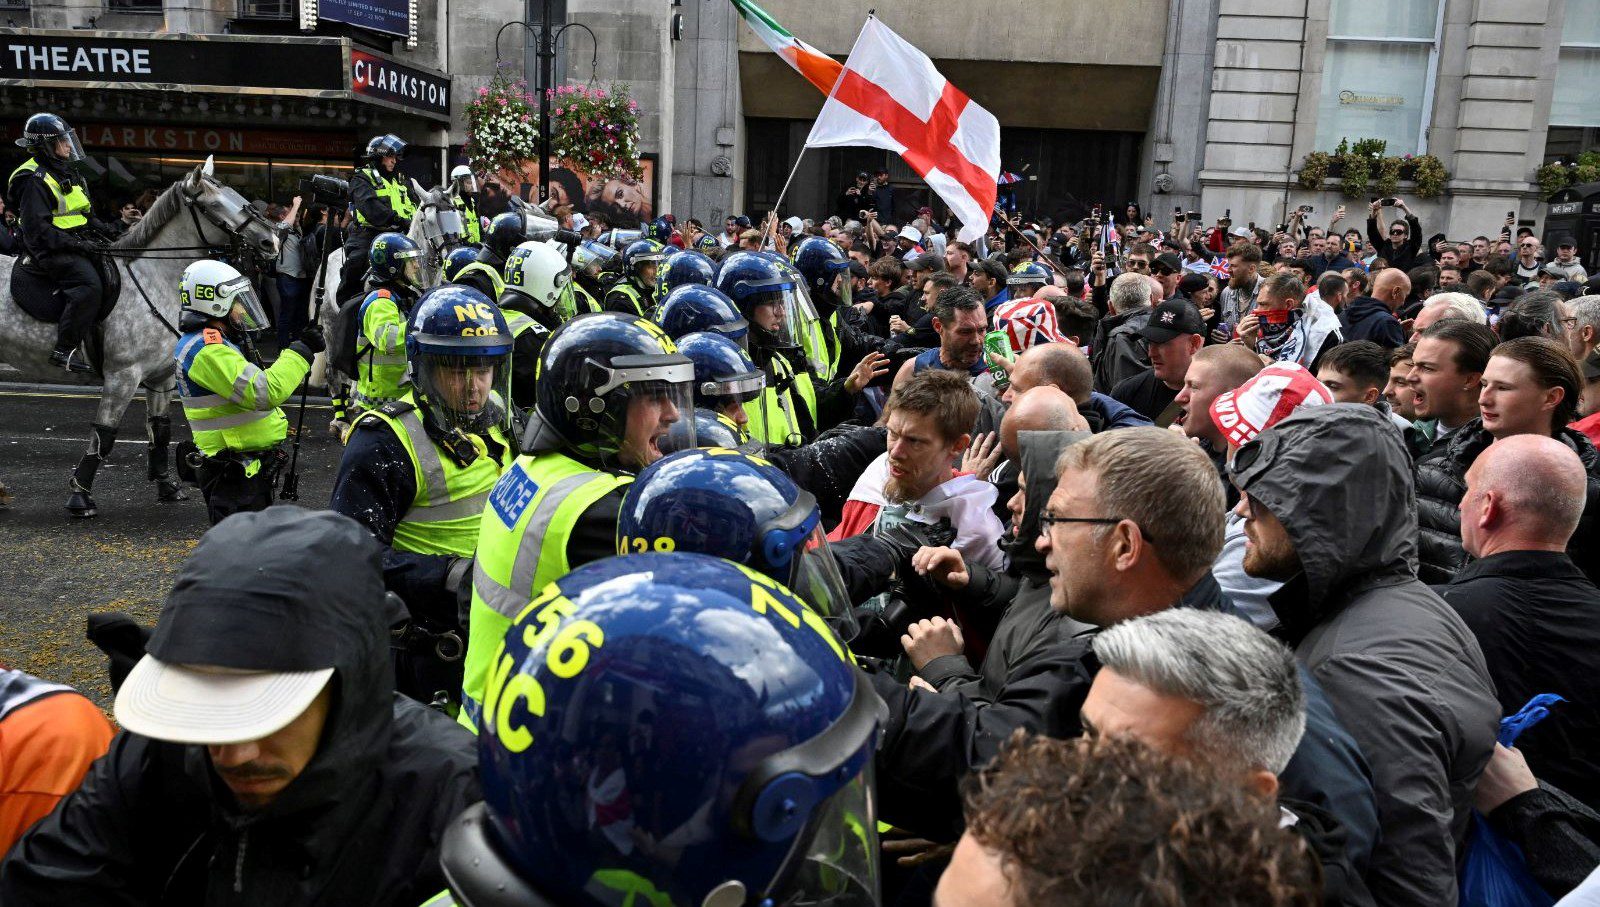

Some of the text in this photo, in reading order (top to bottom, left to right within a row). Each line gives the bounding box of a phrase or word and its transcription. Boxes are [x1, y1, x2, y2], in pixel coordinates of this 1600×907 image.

[348, 0, 369, 10] LIMITED
[388, 9, 408, 19] SEASON
[8, 44, 152, 74] THEATRE
[354, 59, 447, 107] CLARKSTON
[82, 126, 244, 151] LARKSTON
[374, 240, 387, 250] EG
[195, 285, 215, 299] EG
[453, 302, 495, 322] NC
[493, 469, 533, 521] POLICE
